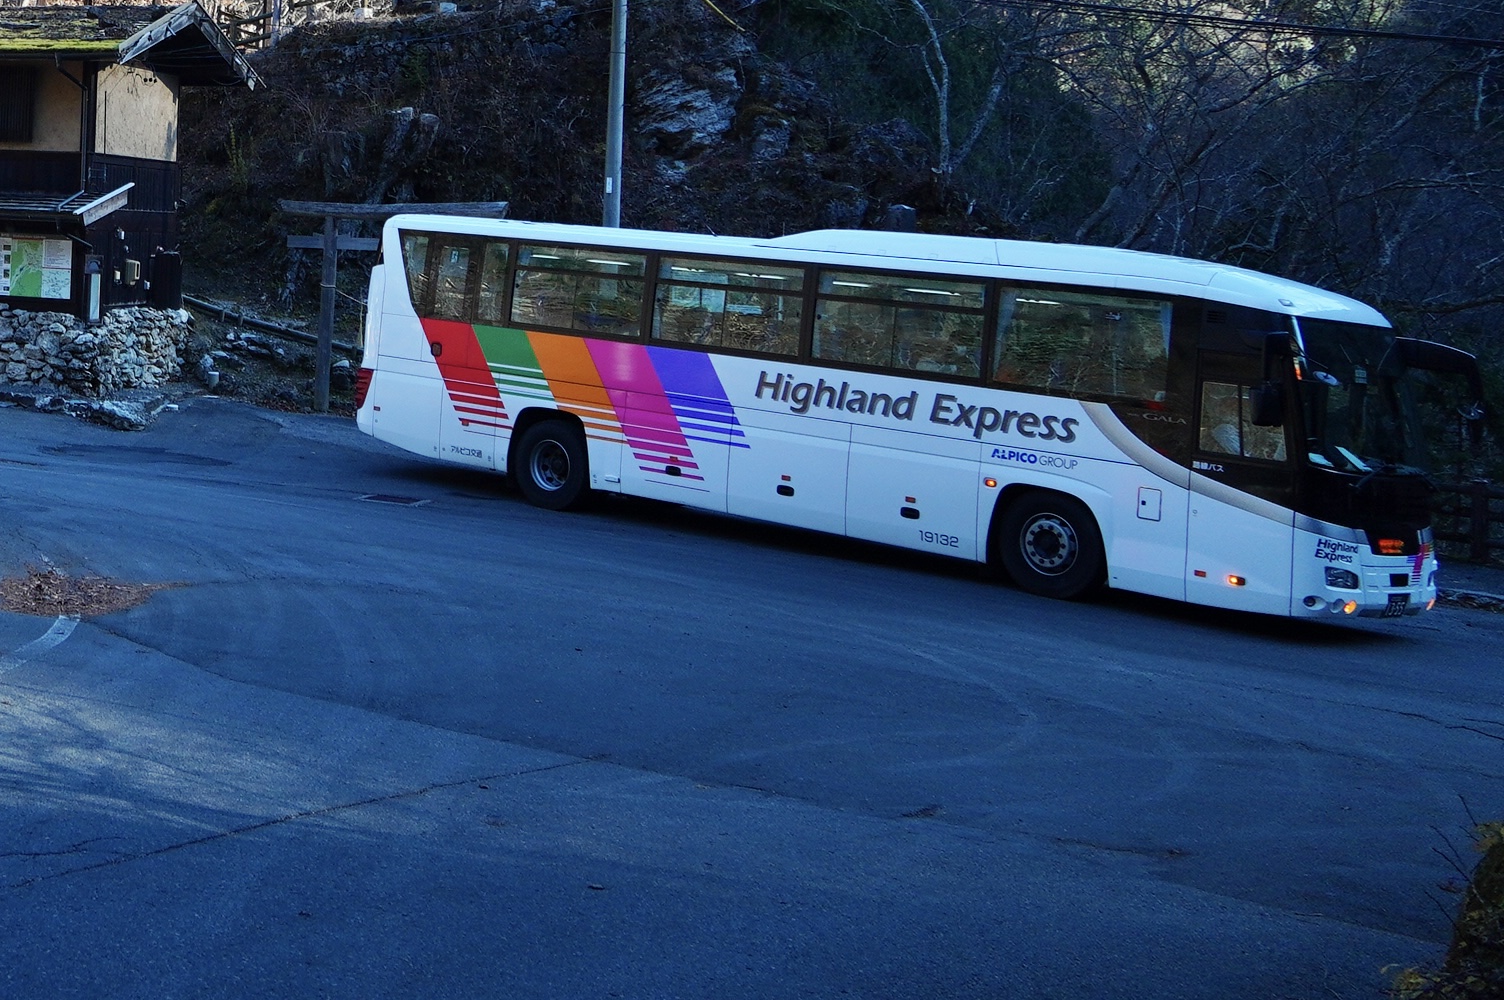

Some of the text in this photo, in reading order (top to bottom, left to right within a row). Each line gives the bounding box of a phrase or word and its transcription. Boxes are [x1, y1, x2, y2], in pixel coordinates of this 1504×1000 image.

[755, 370, 1080, 443] Highland Express
[1142, 412, 1187, 425] GALA
[450, 445, 483, 459] アルピコ交通
[991, 448, 1079, 470] ALPICO GROUP
[919, 530, 960, 549] 19132
[1316, 538, 1359, 555] Highland
[1314, 548, 1353, 563] Express
